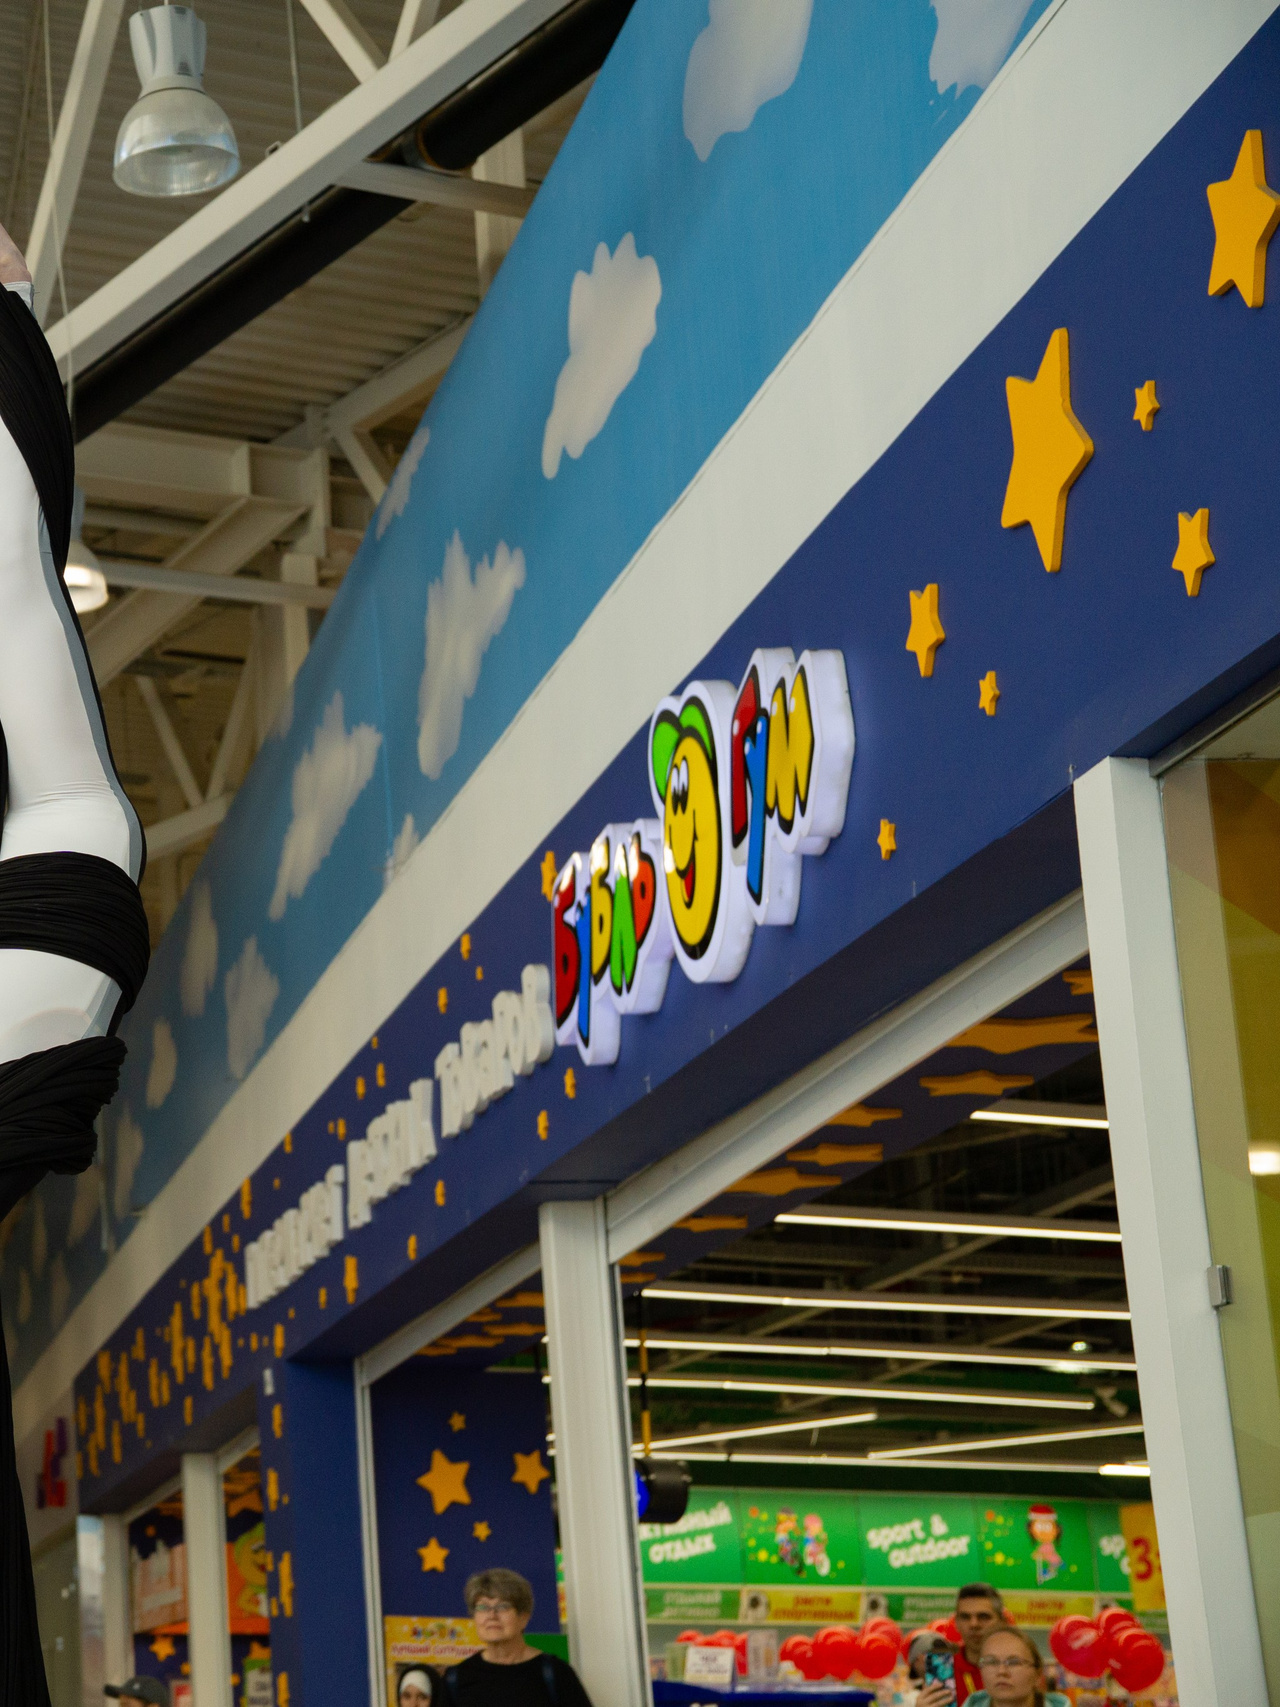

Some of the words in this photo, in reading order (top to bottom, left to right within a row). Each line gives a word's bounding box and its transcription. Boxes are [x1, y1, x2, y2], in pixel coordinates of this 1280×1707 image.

[730, 663, 816, 907] ГУМ
[648, 1533, 717, 1564] ОТДЫХ
[866, 1518, 926, 1553] sport
[888, 1535, 971, 1569] outdoor
